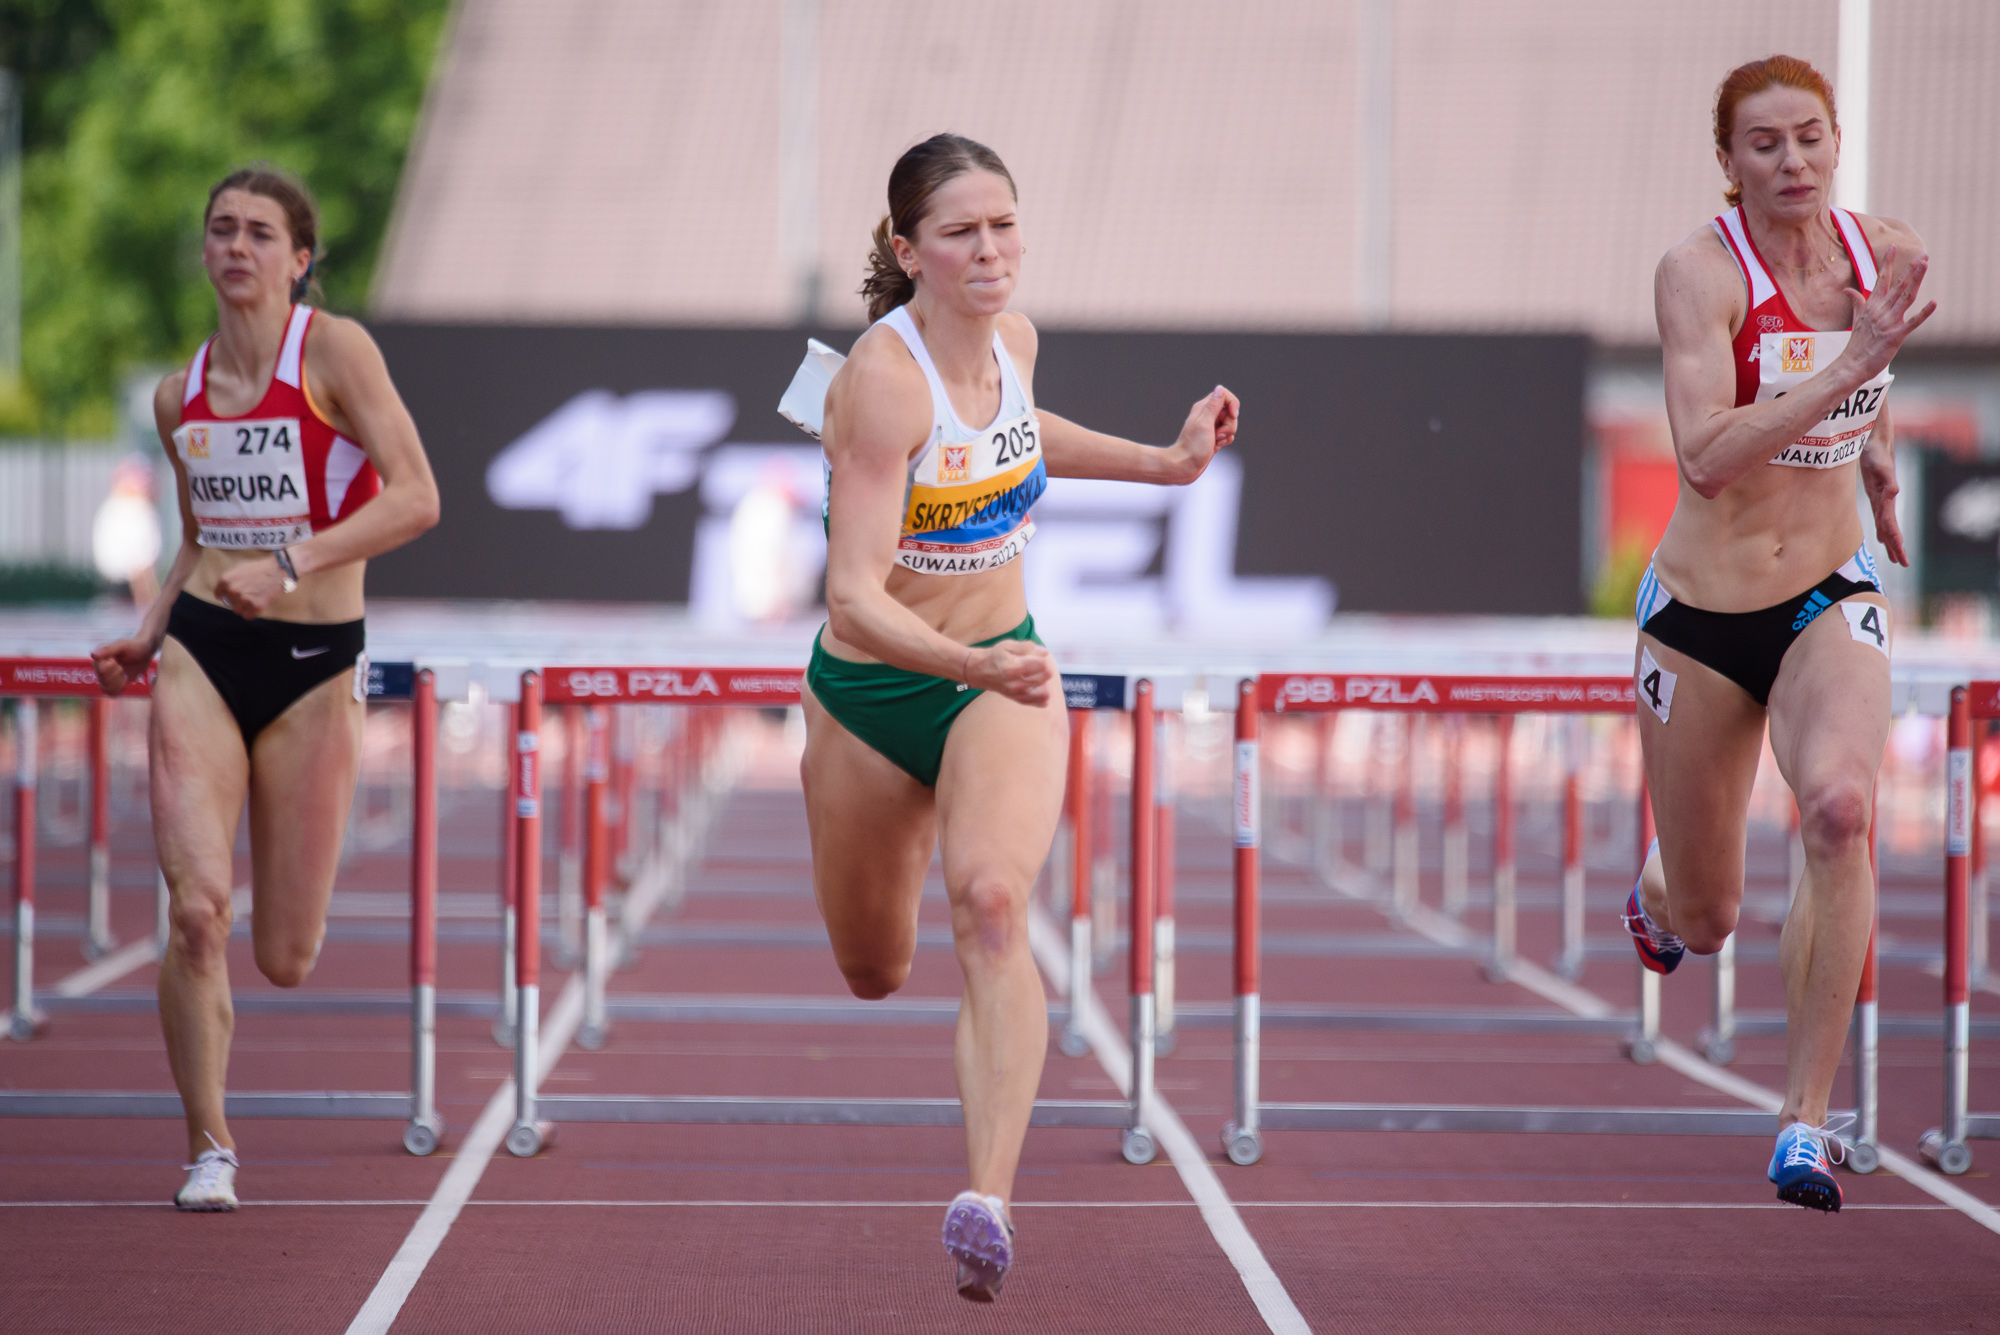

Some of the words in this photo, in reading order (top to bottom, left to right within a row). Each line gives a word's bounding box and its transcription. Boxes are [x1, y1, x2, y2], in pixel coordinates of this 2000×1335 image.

[1785, 360, 1811, 371] PZLA
[236, 427, 291, 455] 274
[992, 421, 1036, 467] 205
[1774, 448, 1829, 465] WAŁKI
[1832, 441, 1856, 463] 2022
[485, 388, 738, 531] 4F
[191, 474, 299, 502] KIEPURA
[912, 476, 1042, 530] SKRZYSZOWSKA
[252, 531, 287, 545] 2022
[922, 544, 951, 553] PZLA
[902, 555, 985, 572] SUWAŁKI
[989, 541, 1020, 568] 2022
[1860, 605, 1885, 647] 4
[627, 670, 720, 697] PZLA
[1345, 677, 1439, 704] PZLA
[1588, 684, 1637, 702] POLS
[1643, 669, 1662, 710] 4
